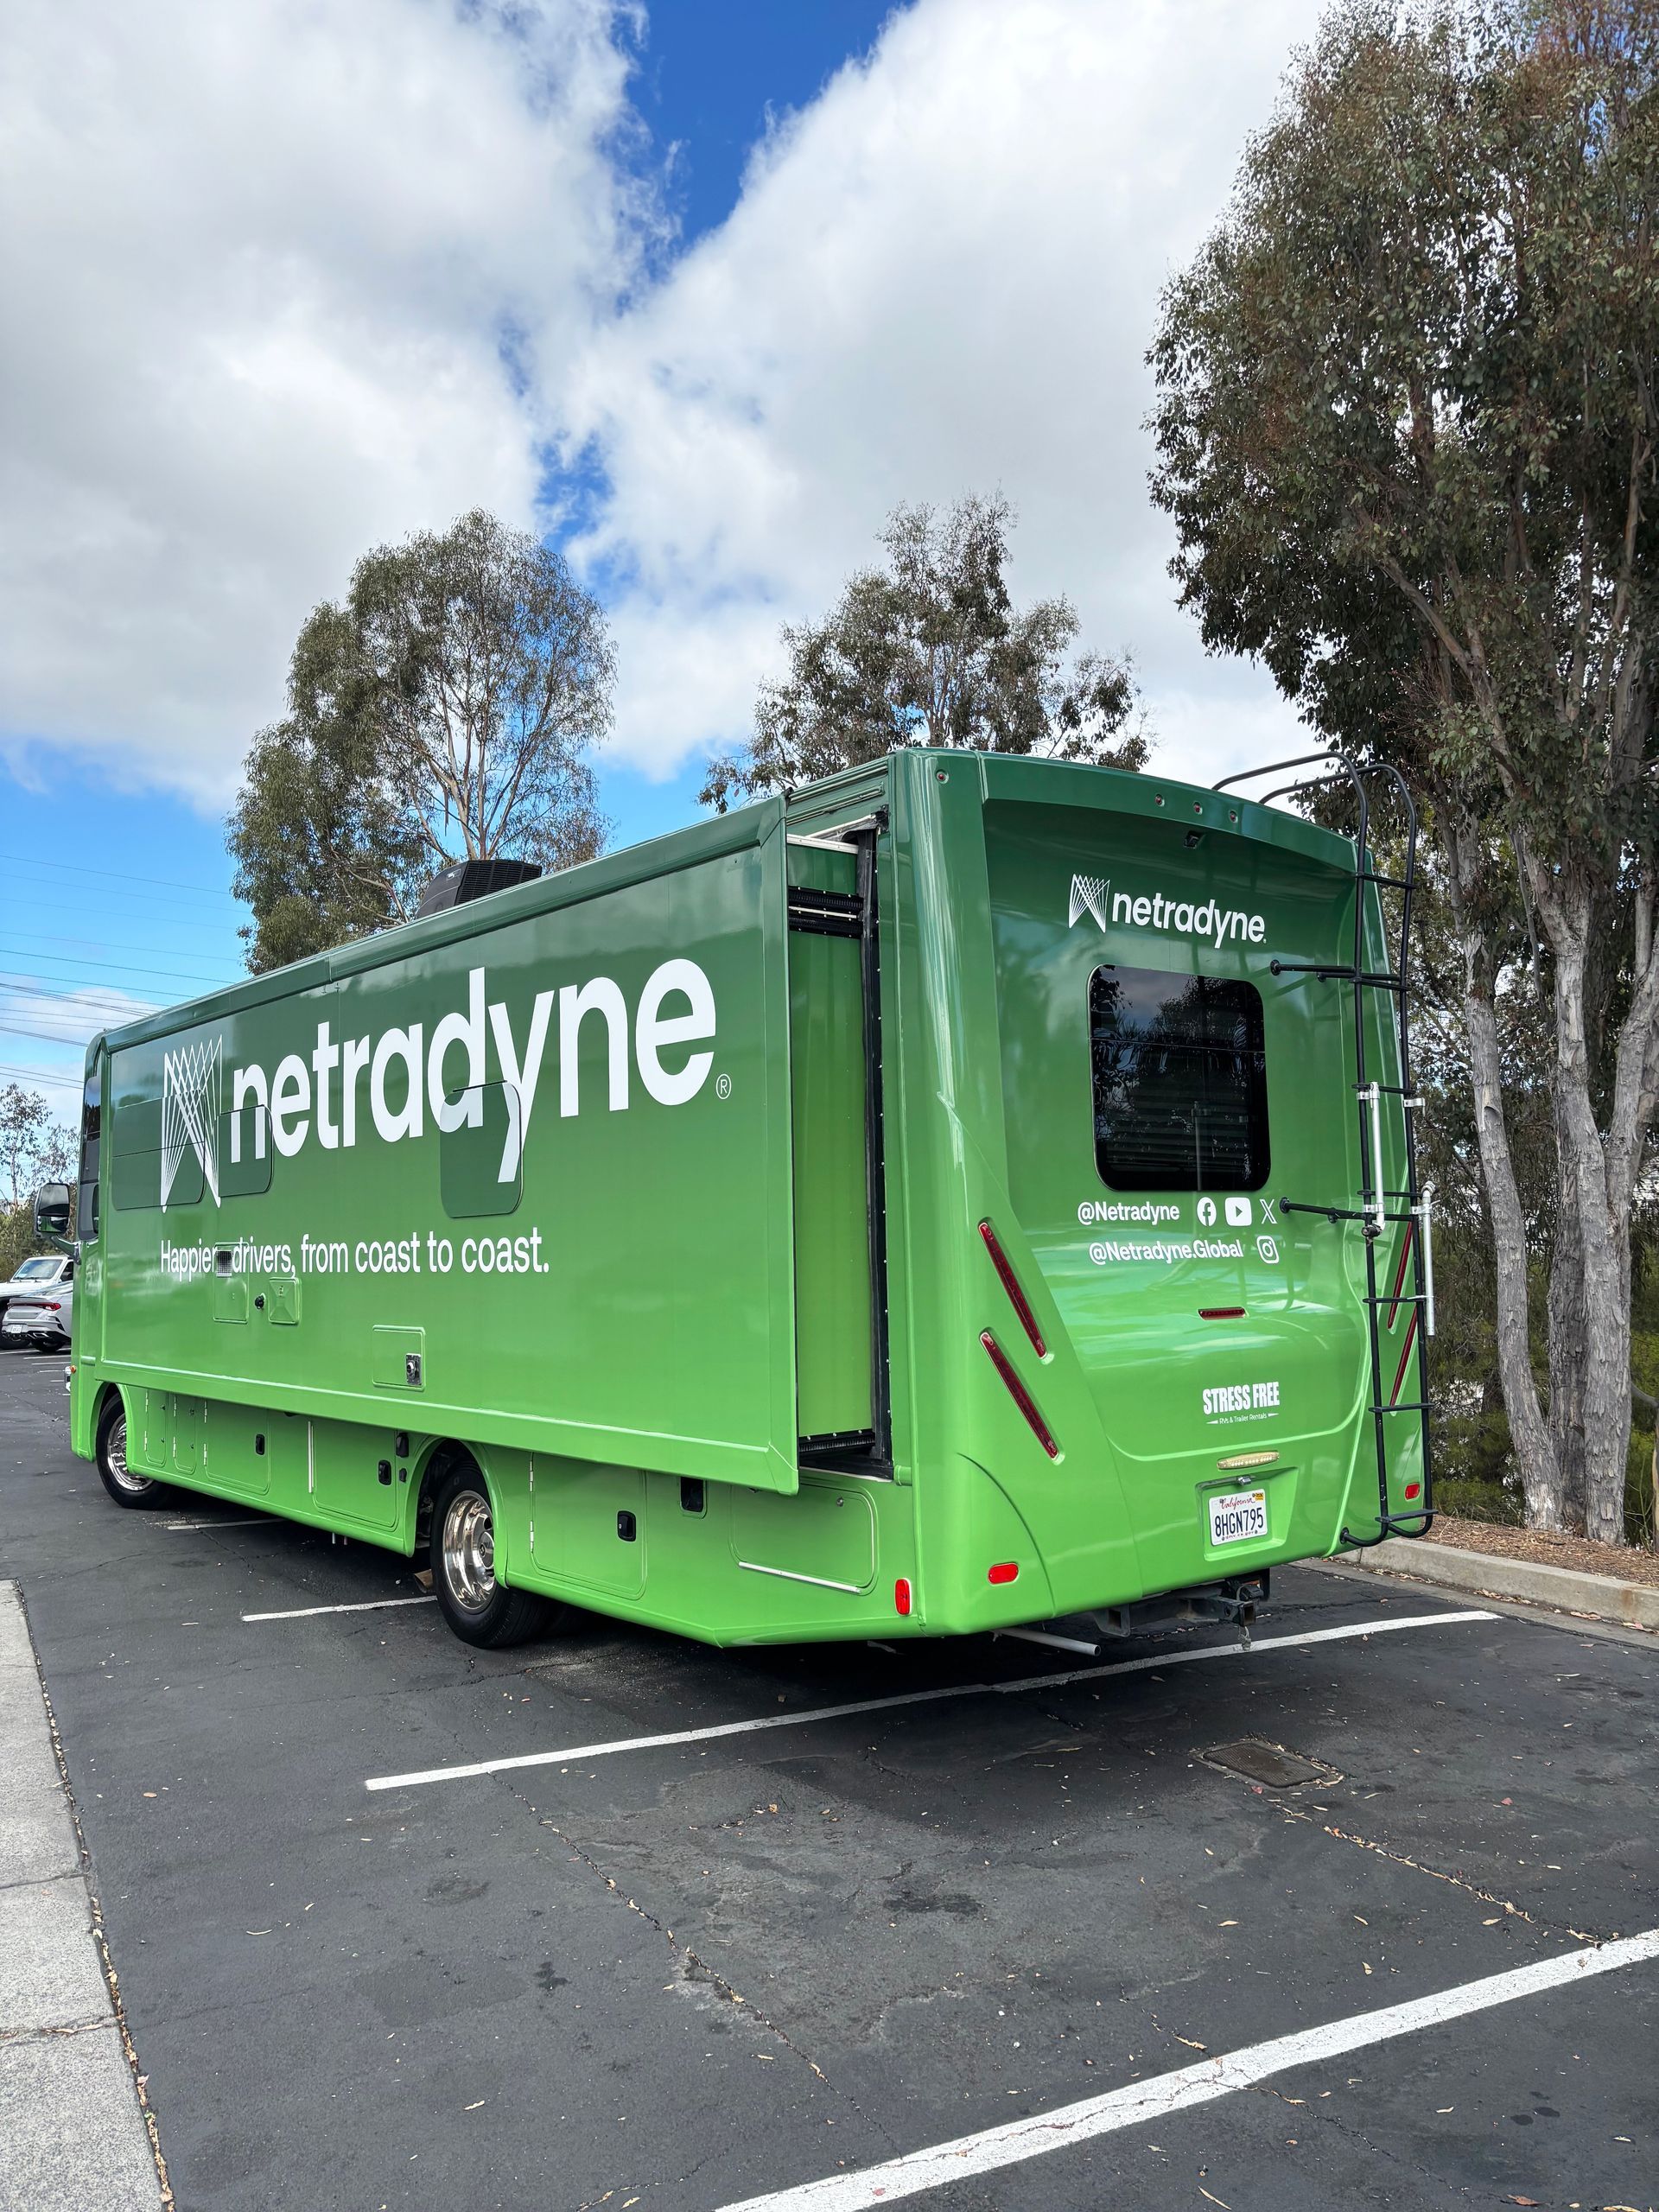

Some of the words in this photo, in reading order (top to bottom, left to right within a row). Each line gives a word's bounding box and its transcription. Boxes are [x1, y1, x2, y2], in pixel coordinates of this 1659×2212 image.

[1077, 1201, 1180, 1225] @Netradyne
[161, 1237, 217, 1282] Happier
[232, 1236, 296, 1278] drivers,
[301, 1234, 349, 1273] from
[355, 1231, 421, 1273] coast
[427, 1230, 454, 1273] to
[461, 1227, 550, 1273] coast.
[1089, 1239, 1244, 1265] @Netradyne.Global
[1202, 1384, 1251, 1415] STRESS
[1252, 1381, 1281, 1408] FREE
[1249, 1412, 1268, 1421] Rentals
[1219, 1496, 1255, 1510] California
[1215, 1506, 1264, 1537] 8HGN795
